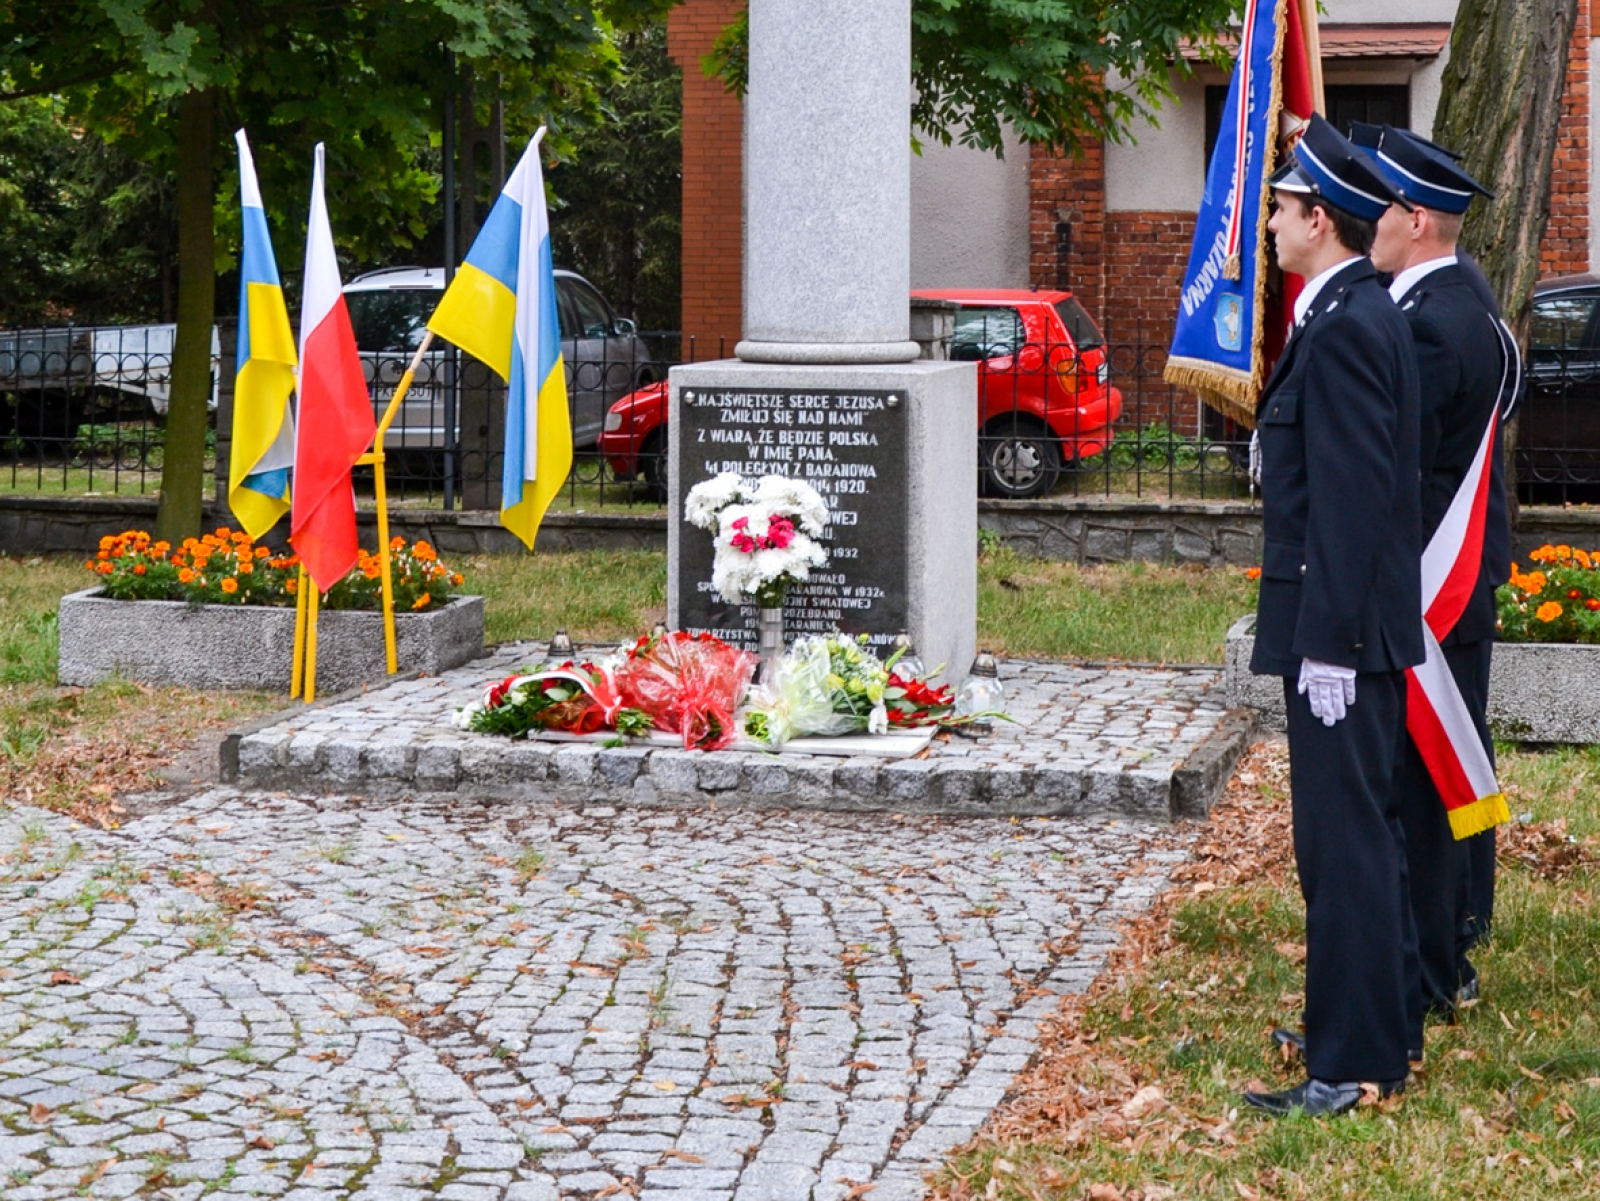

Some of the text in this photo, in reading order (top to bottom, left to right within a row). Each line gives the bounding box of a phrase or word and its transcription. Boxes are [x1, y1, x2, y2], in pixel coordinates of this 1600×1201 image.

[788, 394, 830, 409] SERCE
[834, 395, 885, 411] JEZUSA
[720, 409, 769, 424] ZMIŁUJ
[773, 409, 795, 427] SIĘ
[797, 410, 824, 425] NAD
[697, 428, 706, 443] Z
[778, 429, 825, 447] BĘDZIE
[828, 430, 879, 446] POLSKA
[747, 445, 759, 460] W
[763, 445, 794, 462] IMIĘ
[705, 460, 877, 479] 41 POLEGŁYM Z BARANOWA
[834, 479, 870, 495] 1920.
[832, 547, 859, 558] 1932
[841, 586, 852, 597] W
